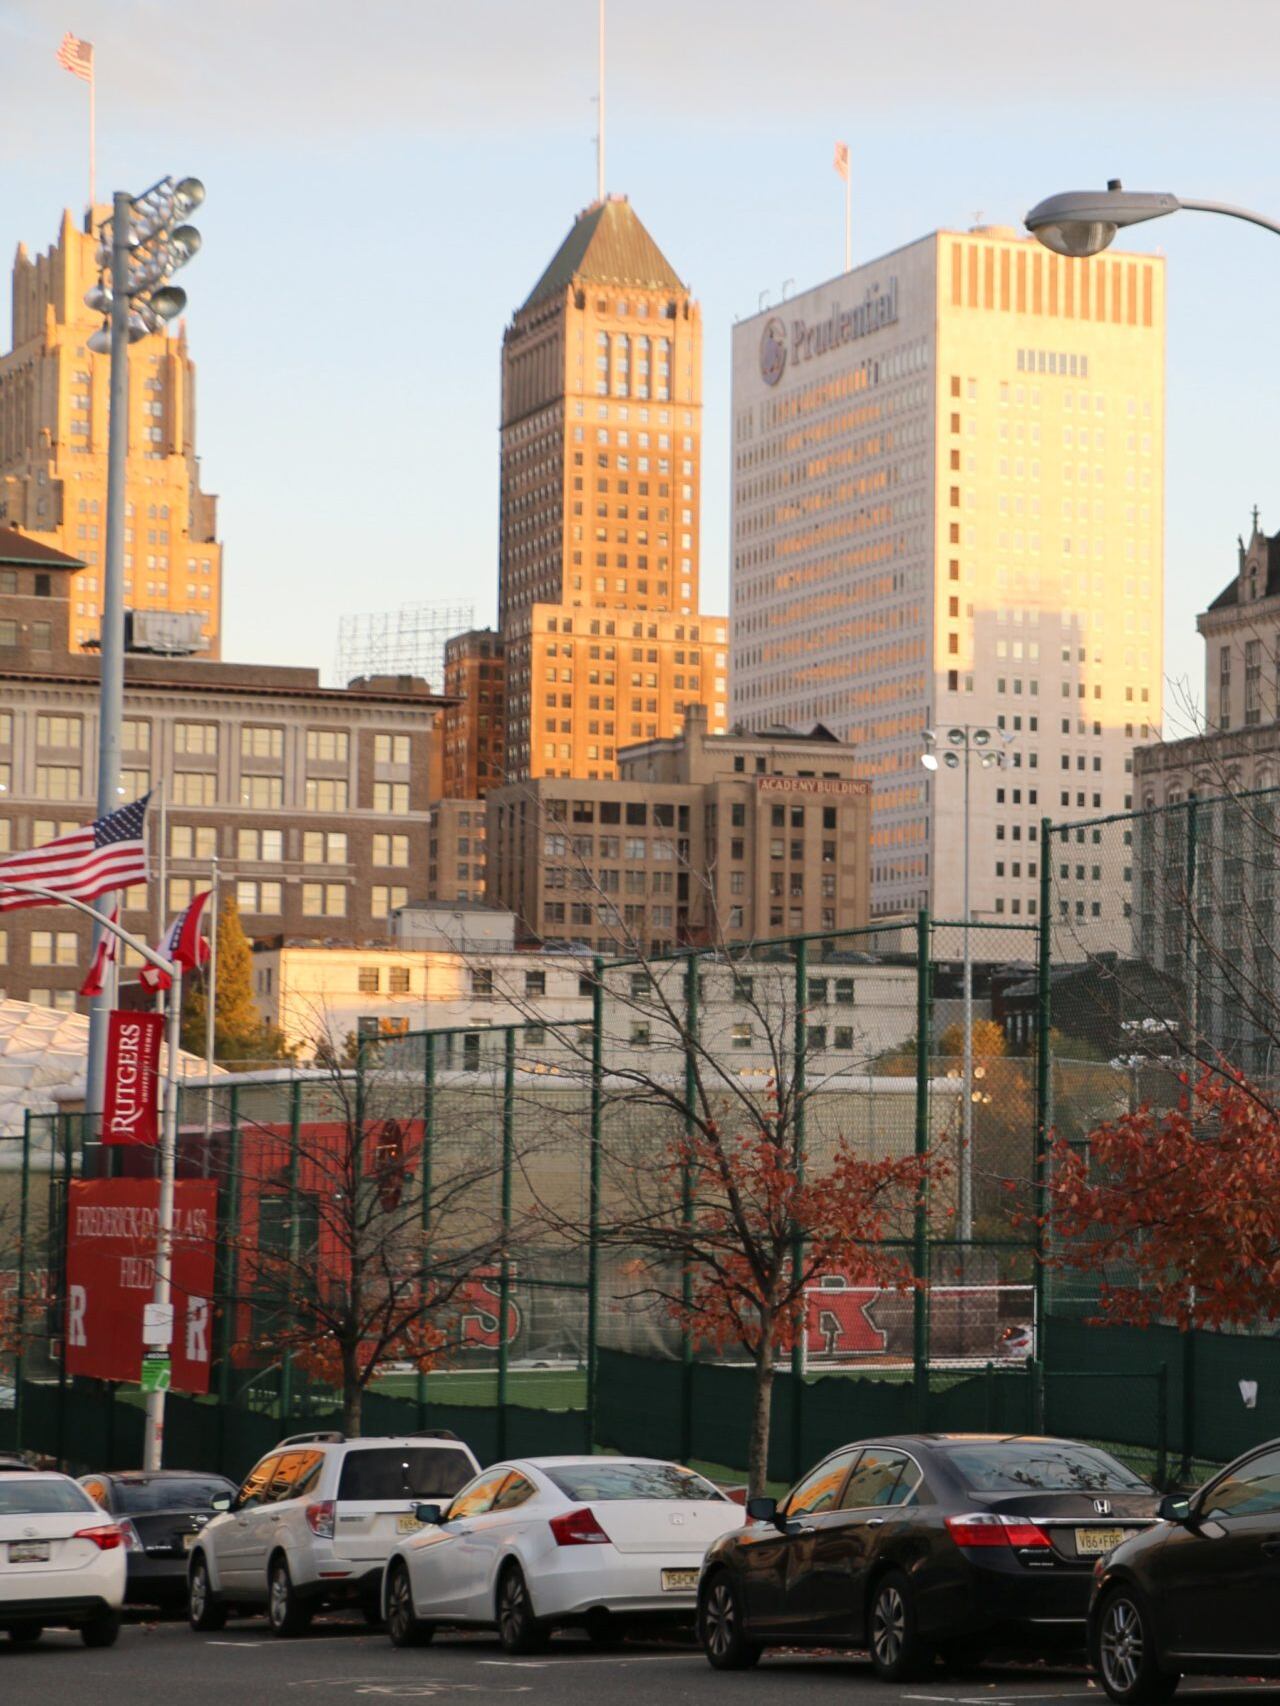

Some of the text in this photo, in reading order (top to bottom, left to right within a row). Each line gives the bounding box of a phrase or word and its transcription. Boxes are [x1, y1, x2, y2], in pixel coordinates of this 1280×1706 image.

[791, 276, 898, 366] Prudential
[761, 780, 867, 795] ACADEMY BUILDING
[110, 1024, 143, 1133] RUTGERS
[76, 1206, 140, 1238] FREDERICK
[120, 1257, 155, 1289] FIELD
[69, 1285, 87, 1346] R
[186, 1295, 208, 1361] R
